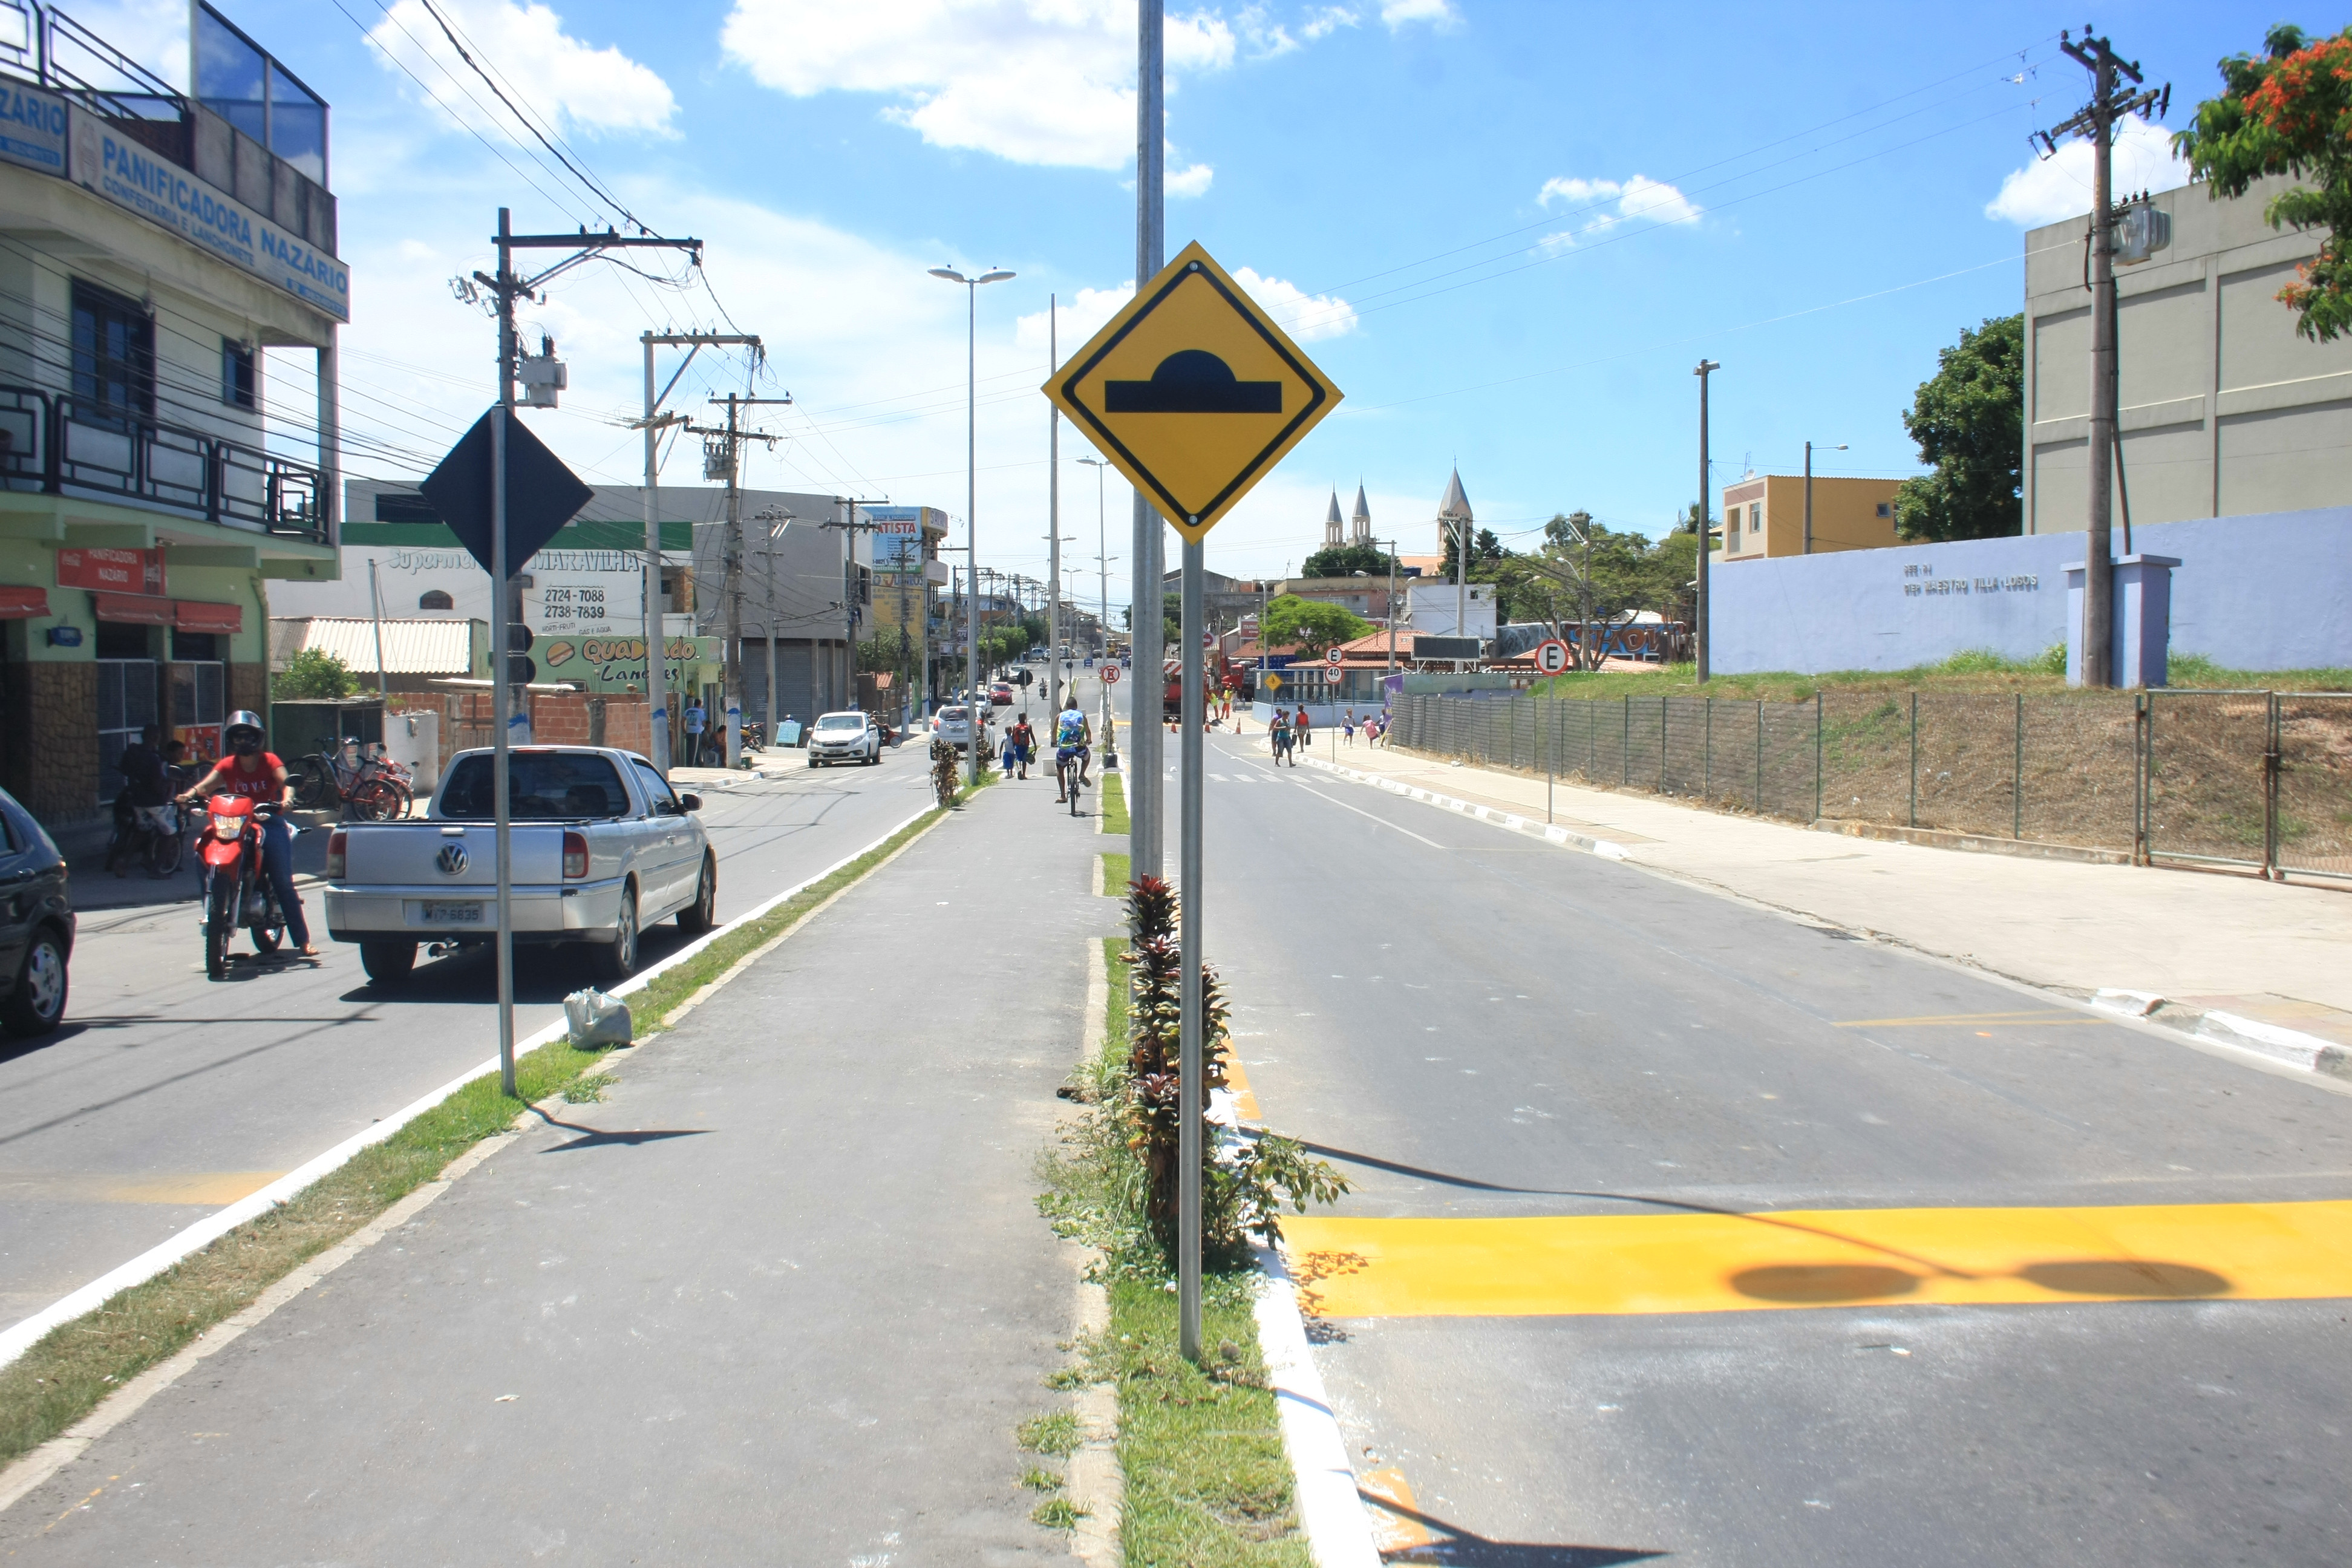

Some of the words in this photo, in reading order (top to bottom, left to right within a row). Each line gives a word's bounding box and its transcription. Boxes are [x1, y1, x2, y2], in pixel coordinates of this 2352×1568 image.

[103, 135, 253, 249] PANIFICADORA
[260, 227, 348, 295] NAZÁRIO
[103, 175, 180, 226] CONFEITARIA
[181, 217, 189, 231] E
[191, 221, 255, 267] LANCHONETE
[875, 523, 916, 534] ATISTA
[89, 549, 138, 564] PANIFICADORA
[388, 547, 478, 575] Supermer
[531, 550, 640, 572] MARAVILHA
[1924, 578, 1968, 593] MAESTRO
[545, 589, 604, 603] 2724-7088
[544, 606, 605, 619] 2738-7839
[542, 622, 575, 633] HORTI-FRUTI
[583, 639, 696, 665] QUADdo
[1331, 649, 1338, 662] E
[1546, 646, 1558, 670] E
[601, 665, 679, 682] Lances
[234, 779, 267, 793] LOVE
